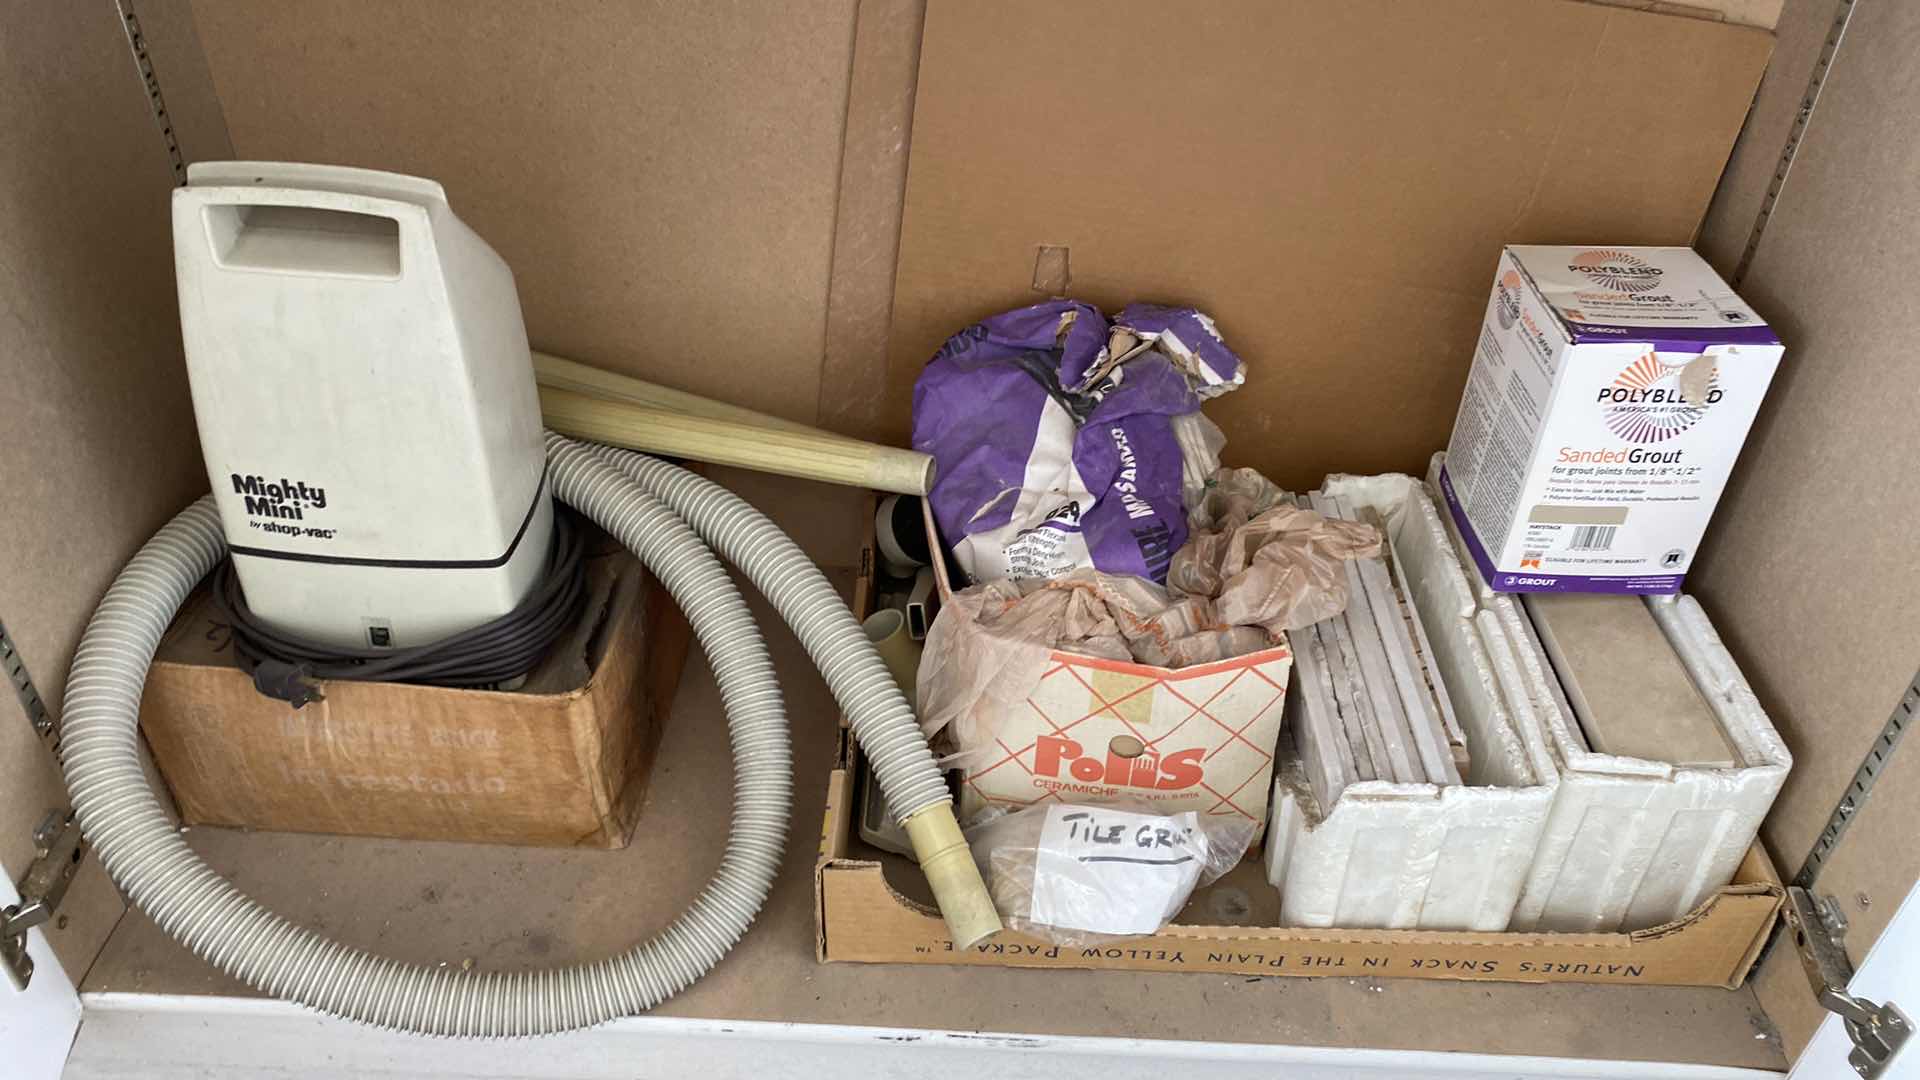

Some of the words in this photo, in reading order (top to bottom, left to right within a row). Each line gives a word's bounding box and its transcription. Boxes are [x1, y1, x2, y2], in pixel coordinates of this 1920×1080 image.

[1568, 264, 1664, 277] POLYBLEND
[1597, 388, 1723, 404] POLYBLD
[1551, 466, 1567, 475] for
[1568, 467, 1594, 477] grout
[1595, 466, 1623, 477] joints
[1624, 466, 1647, 476] from
[231, 473, 327, 509] Mighty
[244, 496, 304, 521] Mini
[250, 520, 262, 529] by
[1518, 577, 1557, 587] GROUT
[1081, 946, 1185, 964] YELLOW
[1207, 951, 1286, 969] PLAIN
[1301, 954, 1346, 969] THE
[1362, 956, 1390, 969] IN
[1408, 957, 1499, 974] SNACK
[1518, 961, 1646, 978] NATURE'S
